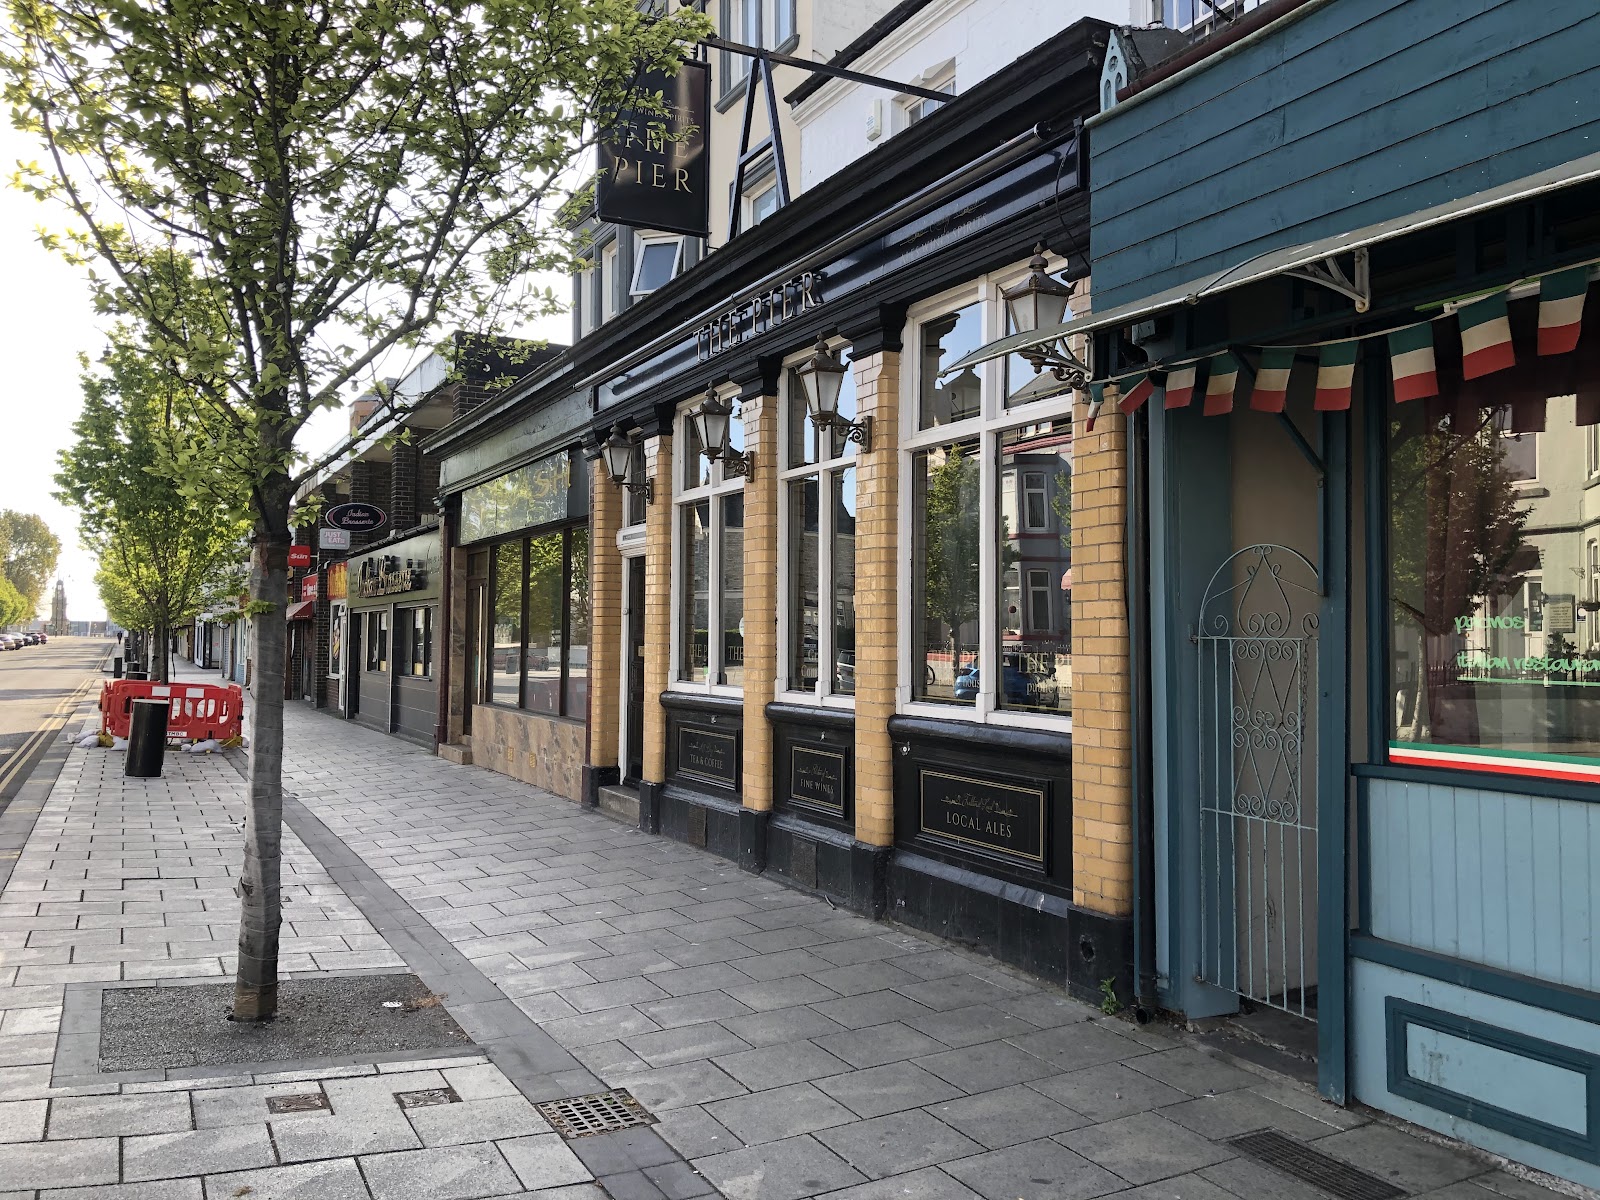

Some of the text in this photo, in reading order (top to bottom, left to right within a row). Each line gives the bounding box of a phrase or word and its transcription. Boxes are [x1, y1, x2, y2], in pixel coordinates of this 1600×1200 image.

[613, 155, 693, 193] PIER
[952, 213, 988, 240] SPIRITS
[693, 271, 817, 362] THE PIER
[704, 757, 723, 770] COFFEE
[800, 778, 834, 794] FINE WINES
[946, 811, 1012, 838] LOCAL ALES
